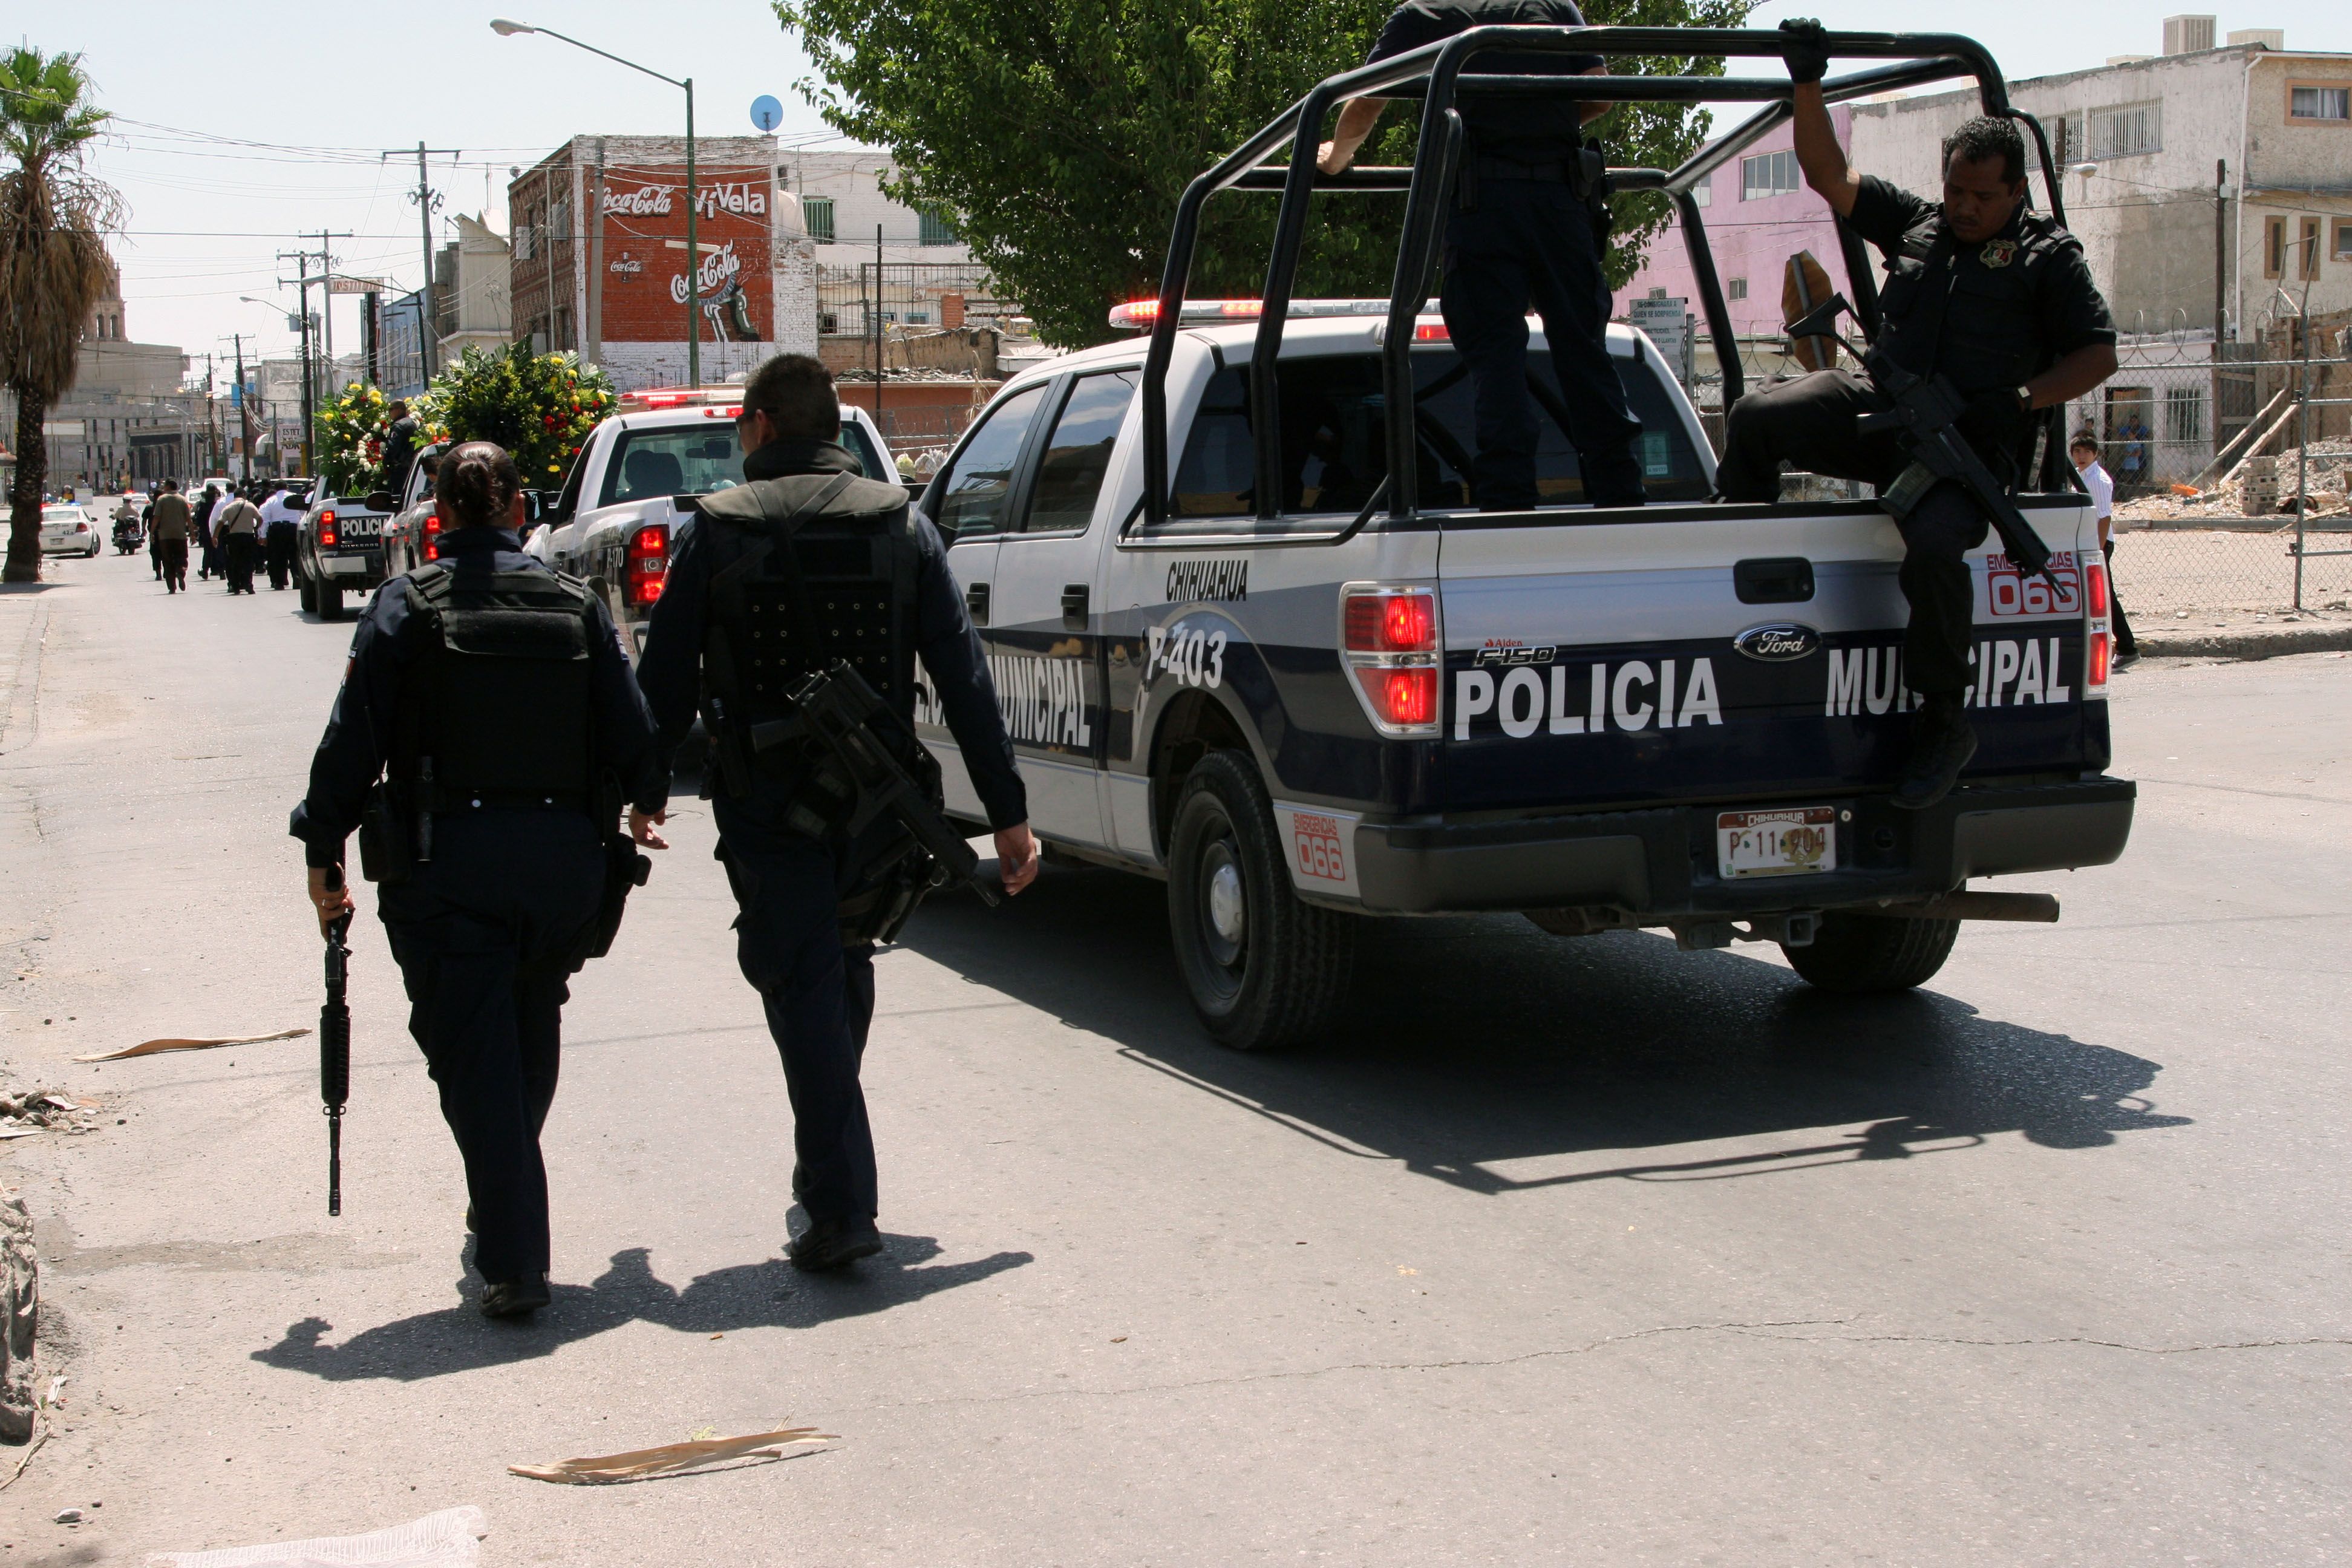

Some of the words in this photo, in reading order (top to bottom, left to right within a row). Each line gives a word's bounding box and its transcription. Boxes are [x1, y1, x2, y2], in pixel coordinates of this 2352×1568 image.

[603, 186, 674, 214] oca-Cola
[610, 261, 642, 272] Coca-Cola
[607, 547, 624, 569] P-170
[1166, 560, 1248, 602] CHIHUAHUA
[1991, 572, 2079, 615] 066
[1495, 638, 1523, 647] Alden
[1757, 631, 1805, 654] Ford
[1147, 626, 1227, 688] P-403
[1454, 657, 1723, 741] POLICIA
[1748, 812, 1805, 826] CHIHUAHUA
[1296, 834, 1344, 880] 066
